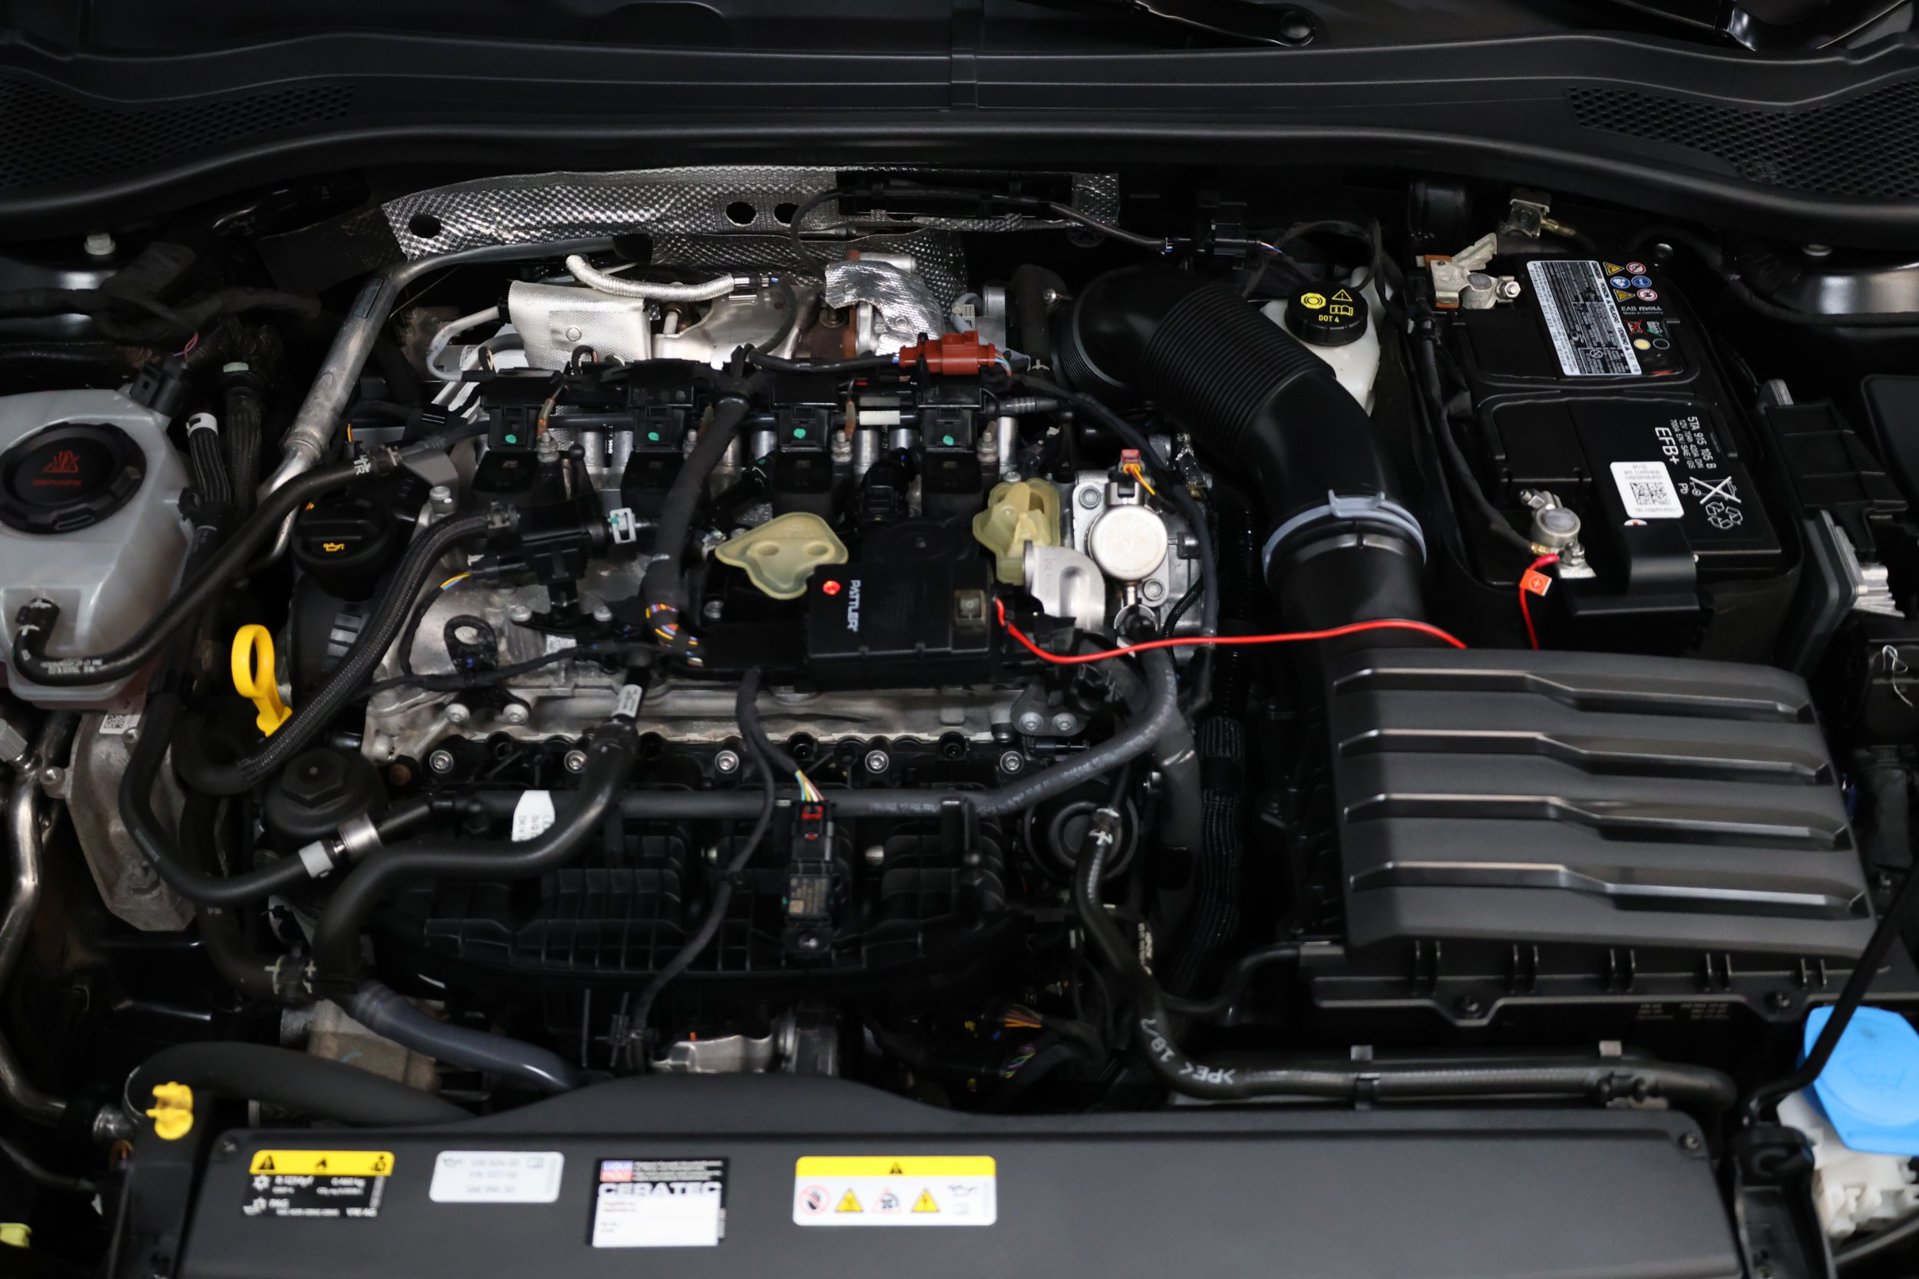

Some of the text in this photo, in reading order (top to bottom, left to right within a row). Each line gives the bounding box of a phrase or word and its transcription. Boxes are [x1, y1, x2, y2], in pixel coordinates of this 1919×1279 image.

[1318, 314, 1332, 322] DOT
[1687, 416, 1700, 430] 5TA
[1694, 432, 1707, 445] 915
[1654, 427, 1680, 464] EFB+
[1678, 482, 1689, 494] Pb
